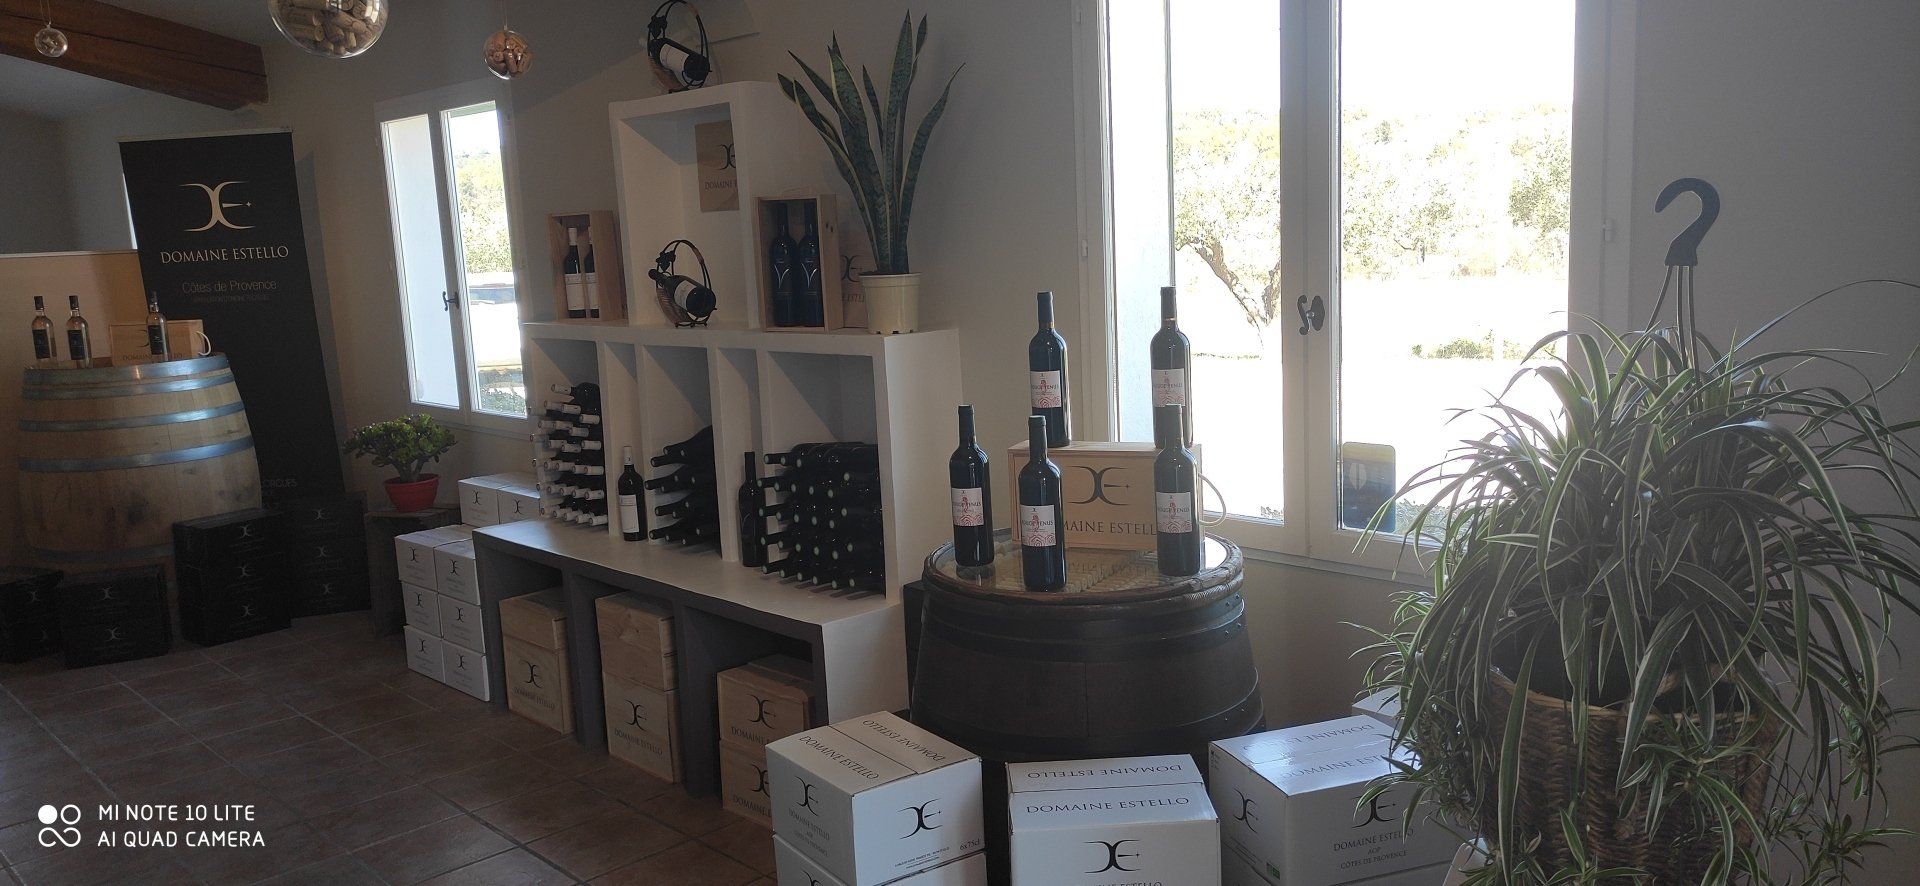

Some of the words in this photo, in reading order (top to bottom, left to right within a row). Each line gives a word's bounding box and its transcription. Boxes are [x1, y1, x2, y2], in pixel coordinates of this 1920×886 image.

[160, 249, 229, 264] DOMAINE
[233, 246, 289, 260] ESTELLO
[182, 280, 213, 294] Côtes
[215, 281, 227, 292] de
[230, 280, 278, 291] Provence
[1064, 520, 1104, 534] MAINE
[1110, 522, 1157, 537] ESTELL
[861, 718, 902, 743] ESTELLO
[801, 735, 844, 764] DOMAINE
[843, 754, 881, 782] ESTELLO
[898, 740, 947, 763] DOMAINE
[1028, 769, 1094, 780] ESTELLO
[1102, 764, 1183, 778] DOMAINE
[1281, 761, 1354, 781] DOMAINE
[1027, 802, 1113, 815] DOMAINE
[1119, 797, 1190, 811] ESTELLO
[959, 837, 981, 851] 6x75cl
[1333, 836, 1377, 852] DOMAINE
[1379, 829, 1415, 843] ESTELO
[1363, 856, 1373, 865] DE
[1374, 850, 1407, 863] PROVENCE
